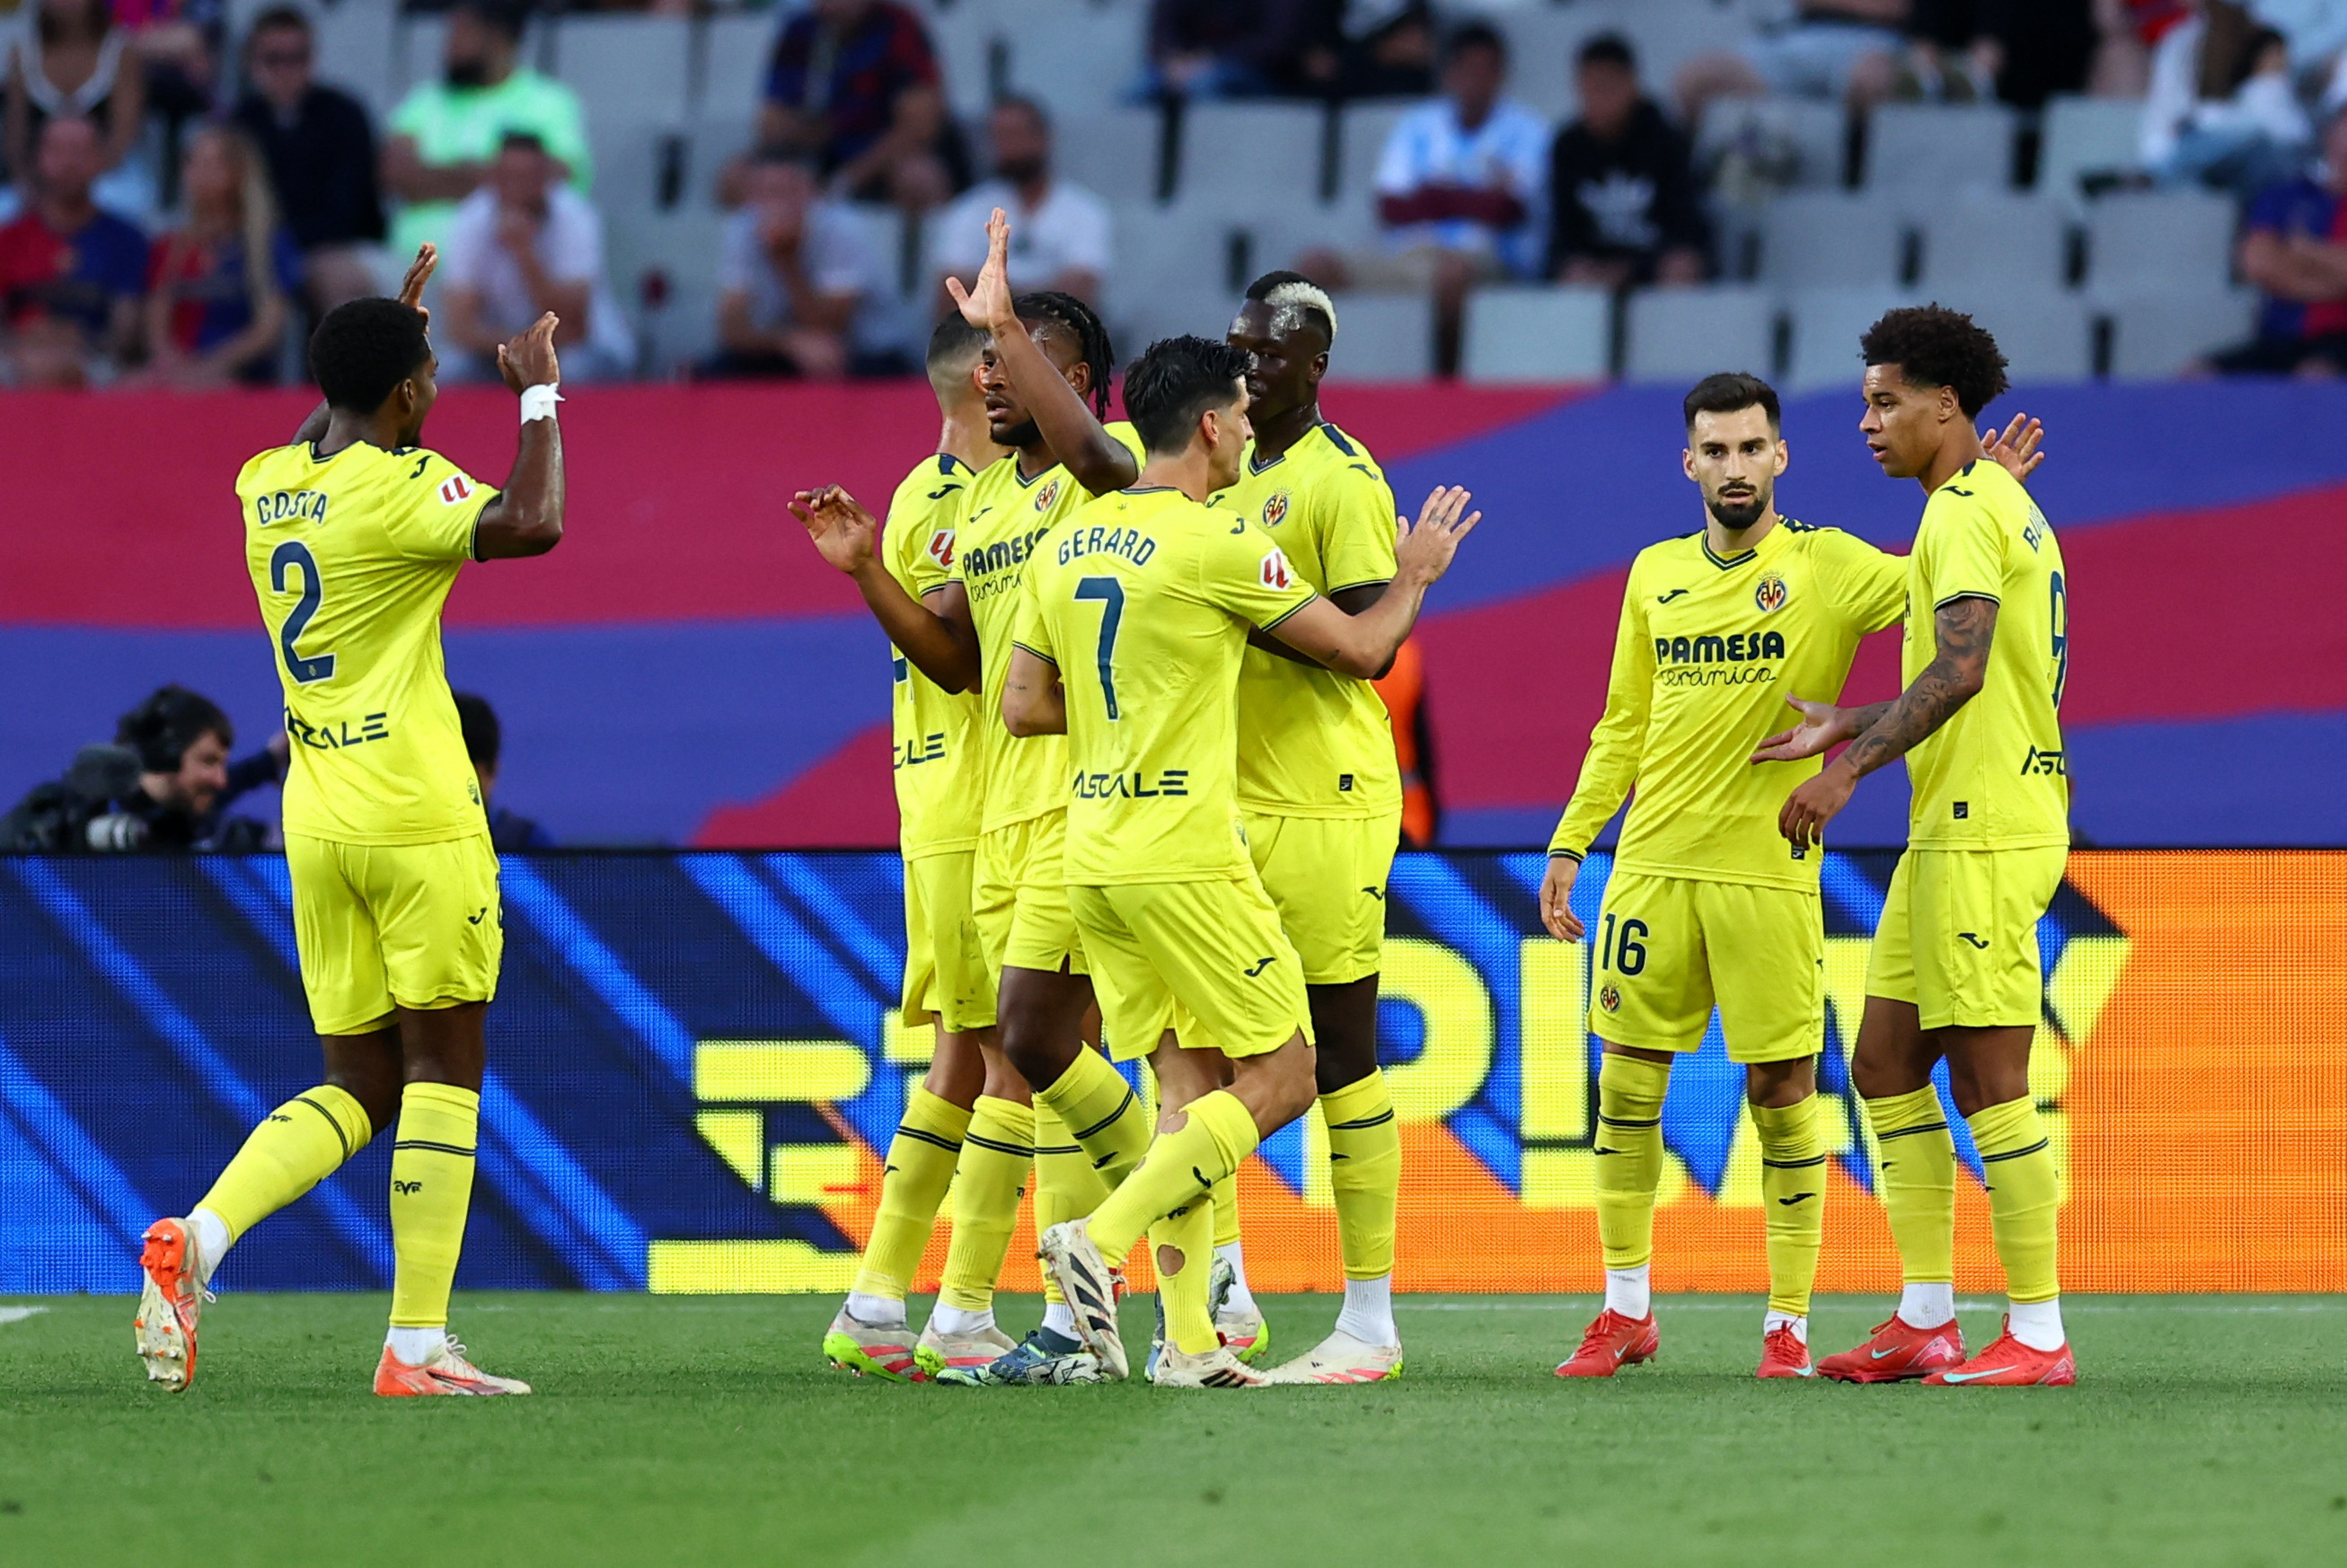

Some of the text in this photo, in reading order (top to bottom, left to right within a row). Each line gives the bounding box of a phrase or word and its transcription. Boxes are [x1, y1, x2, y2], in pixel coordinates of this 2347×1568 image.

[257, 491, 328, 524] COSTA
[963, 527, 1050, 580] PAMES
[1058, 526, 1157, 566] GERARD
[971, 569, 1021, 603] cerámi
[270, 540, 336, 684] 2
[1073, 577, 1125, 721] 7
[1655, 630, 1785, 665] PAMESA
[1601, 912, 1649, 976] 16
